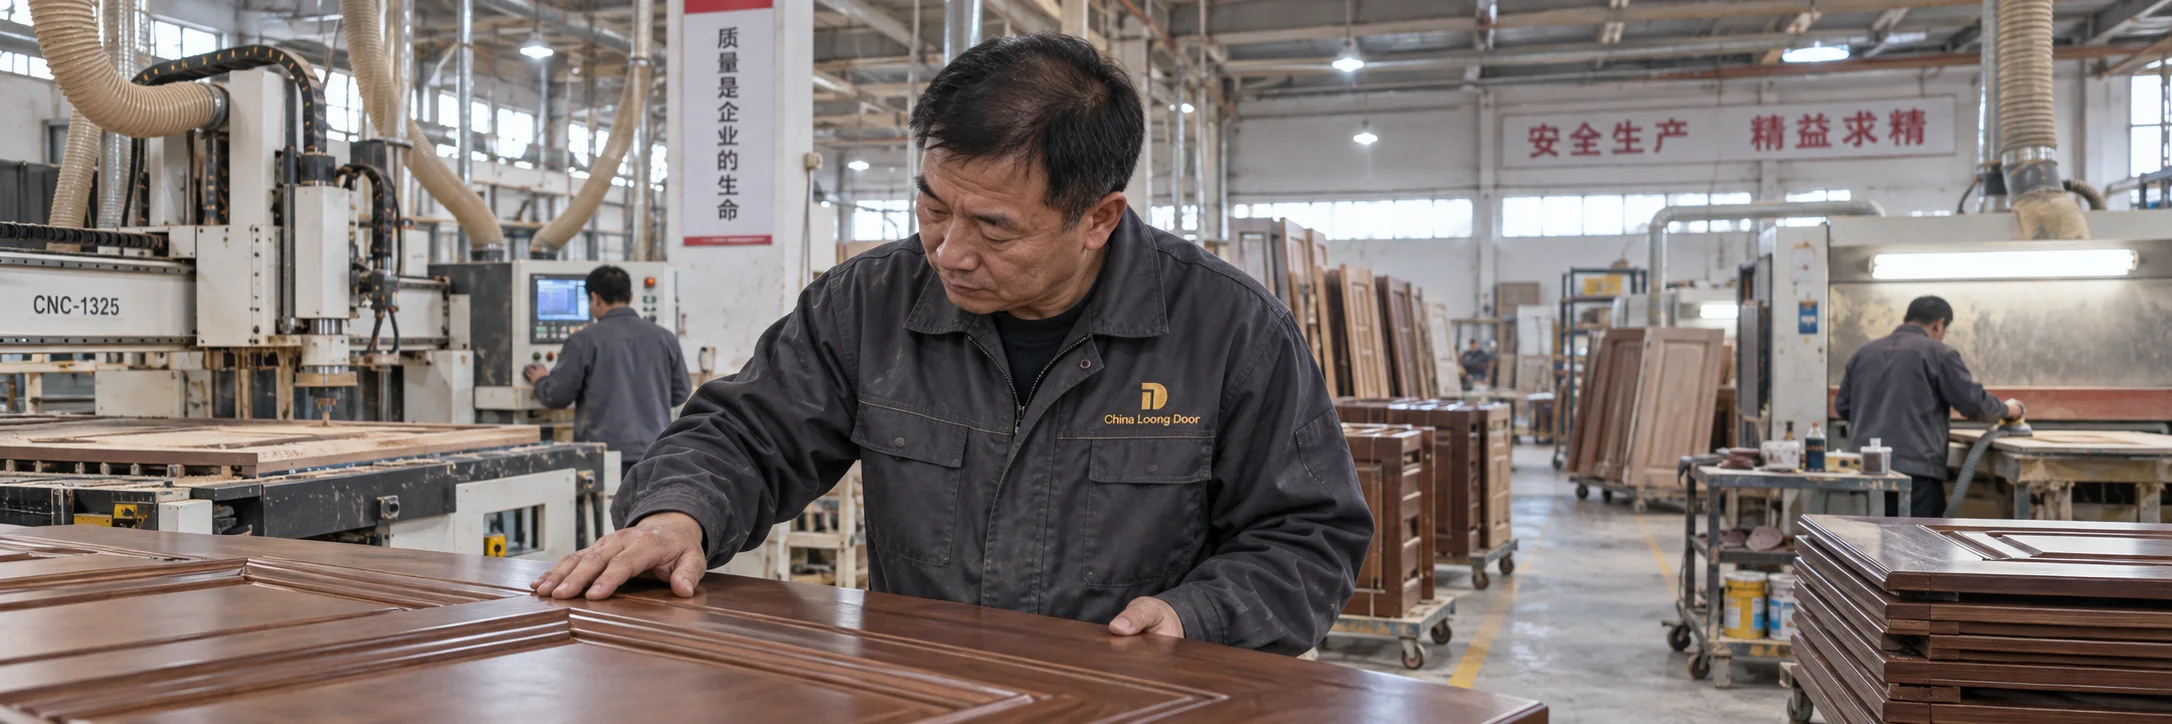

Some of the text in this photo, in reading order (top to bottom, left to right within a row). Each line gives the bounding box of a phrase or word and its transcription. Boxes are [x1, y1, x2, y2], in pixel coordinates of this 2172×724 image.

[717, 26, 739, 221] 质量是企业的生命
[1528, 107, 1927, 159] 安全生产 精益求精
[33, 294, 120, 316] CNC-1325
[1104, 413, 1200, 427] China Loong Door
